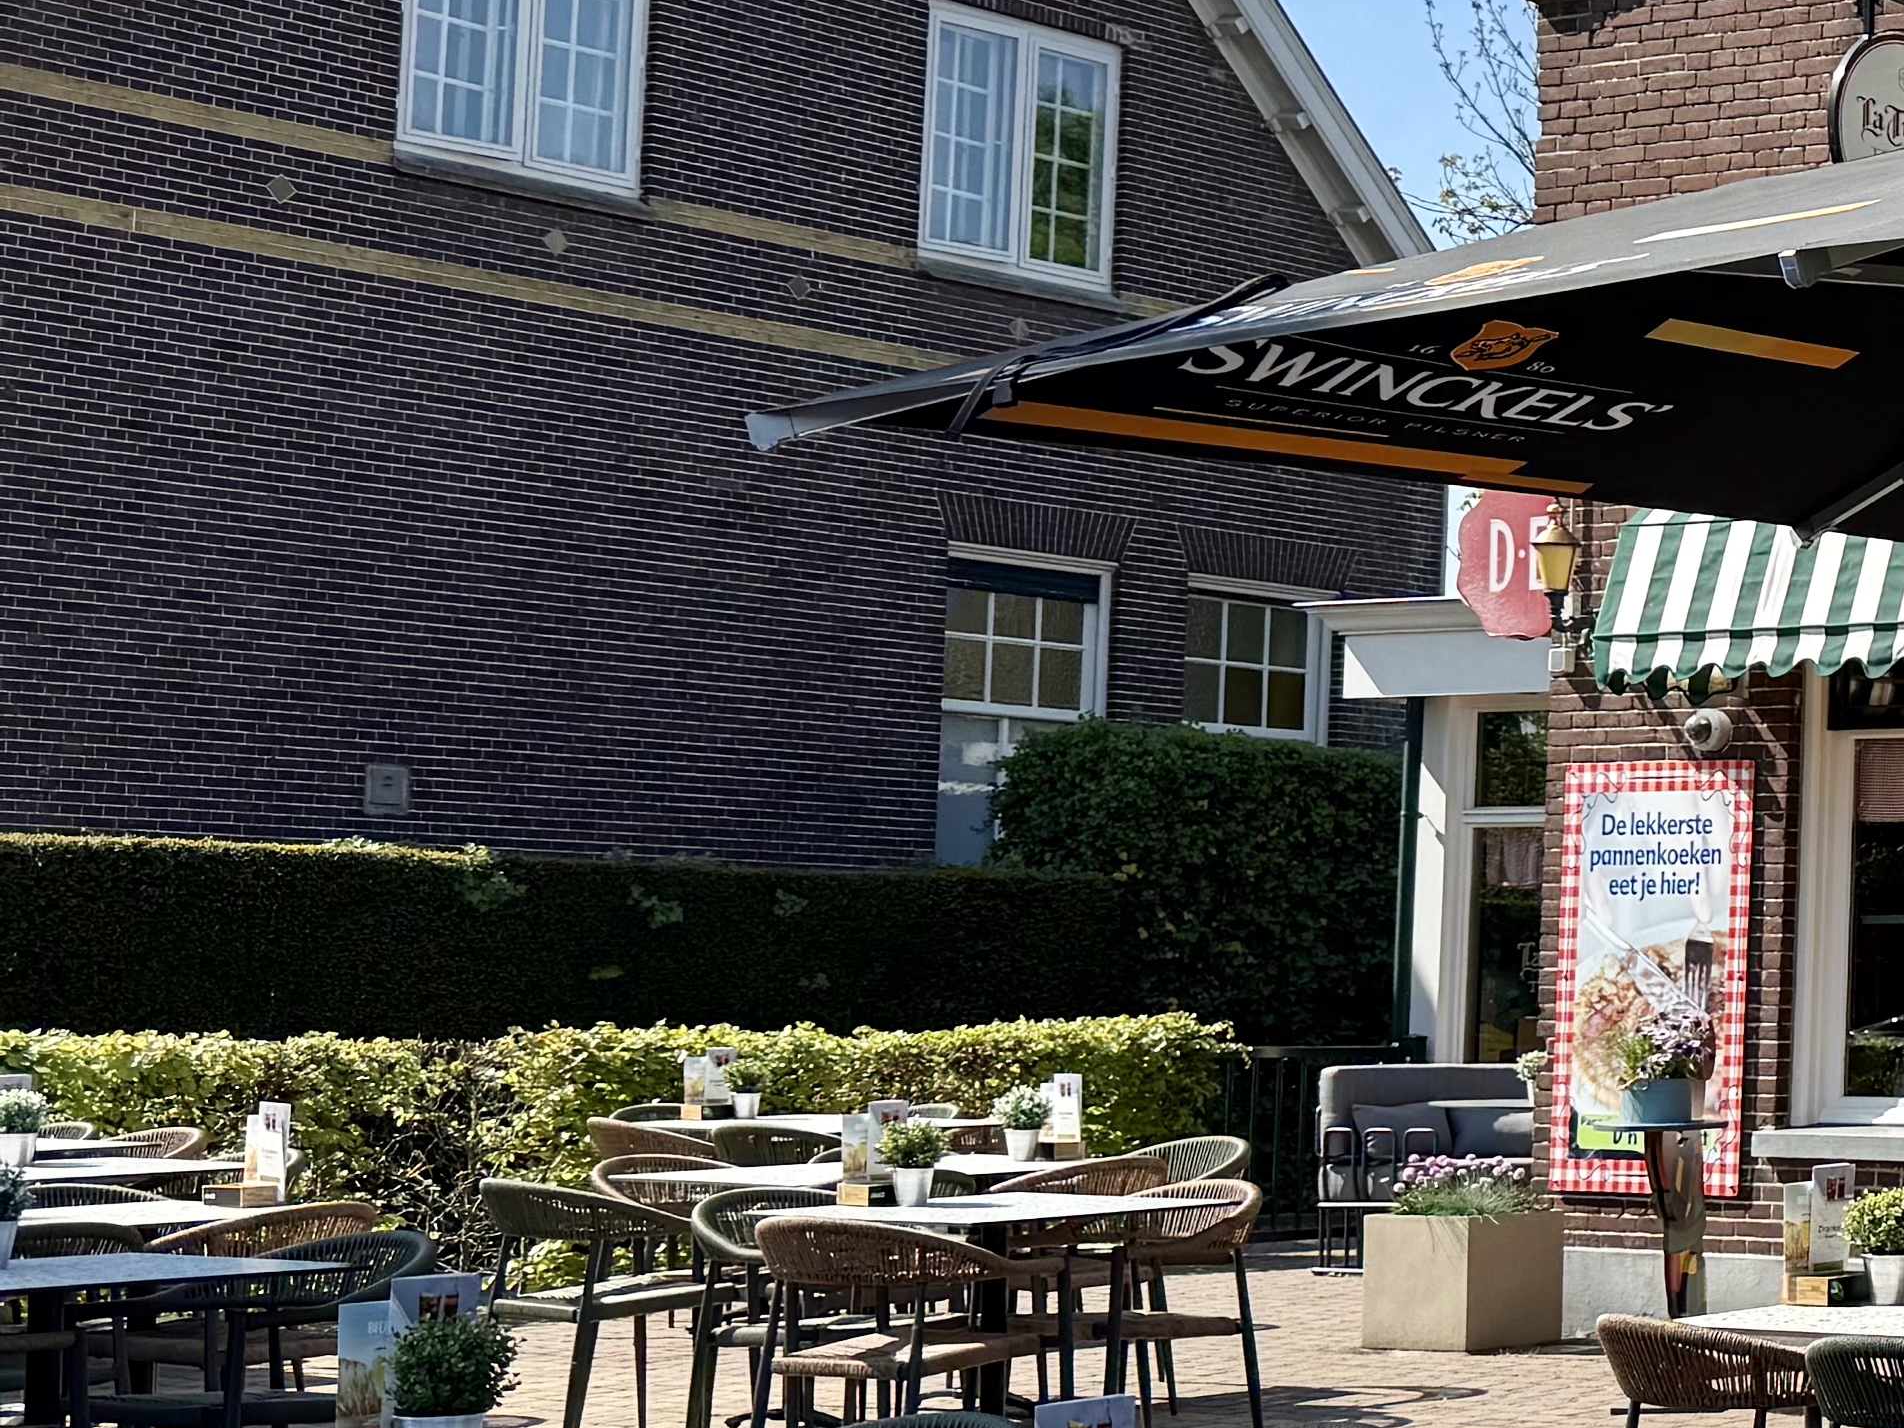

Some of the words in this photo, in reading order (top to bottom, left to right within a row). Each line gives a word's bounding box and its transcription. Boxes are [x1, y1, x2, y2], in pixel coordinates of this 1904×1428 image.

[1856, 96, 1884, 143] La
[1224, 399, 1388, 427] SUPERIOR
[1403, 422, 1527, 444] PILSNER
[1601, 813, 1626, 836] De
[1630, 811, 1713, 836] lekkerste
[1589, 841, 1722, 872] pannenkoeken
[1609, 875, 1638, 896] eet
[1639, 871, 1657, 902] je
[1660, 871, 1700, 896] hier!
